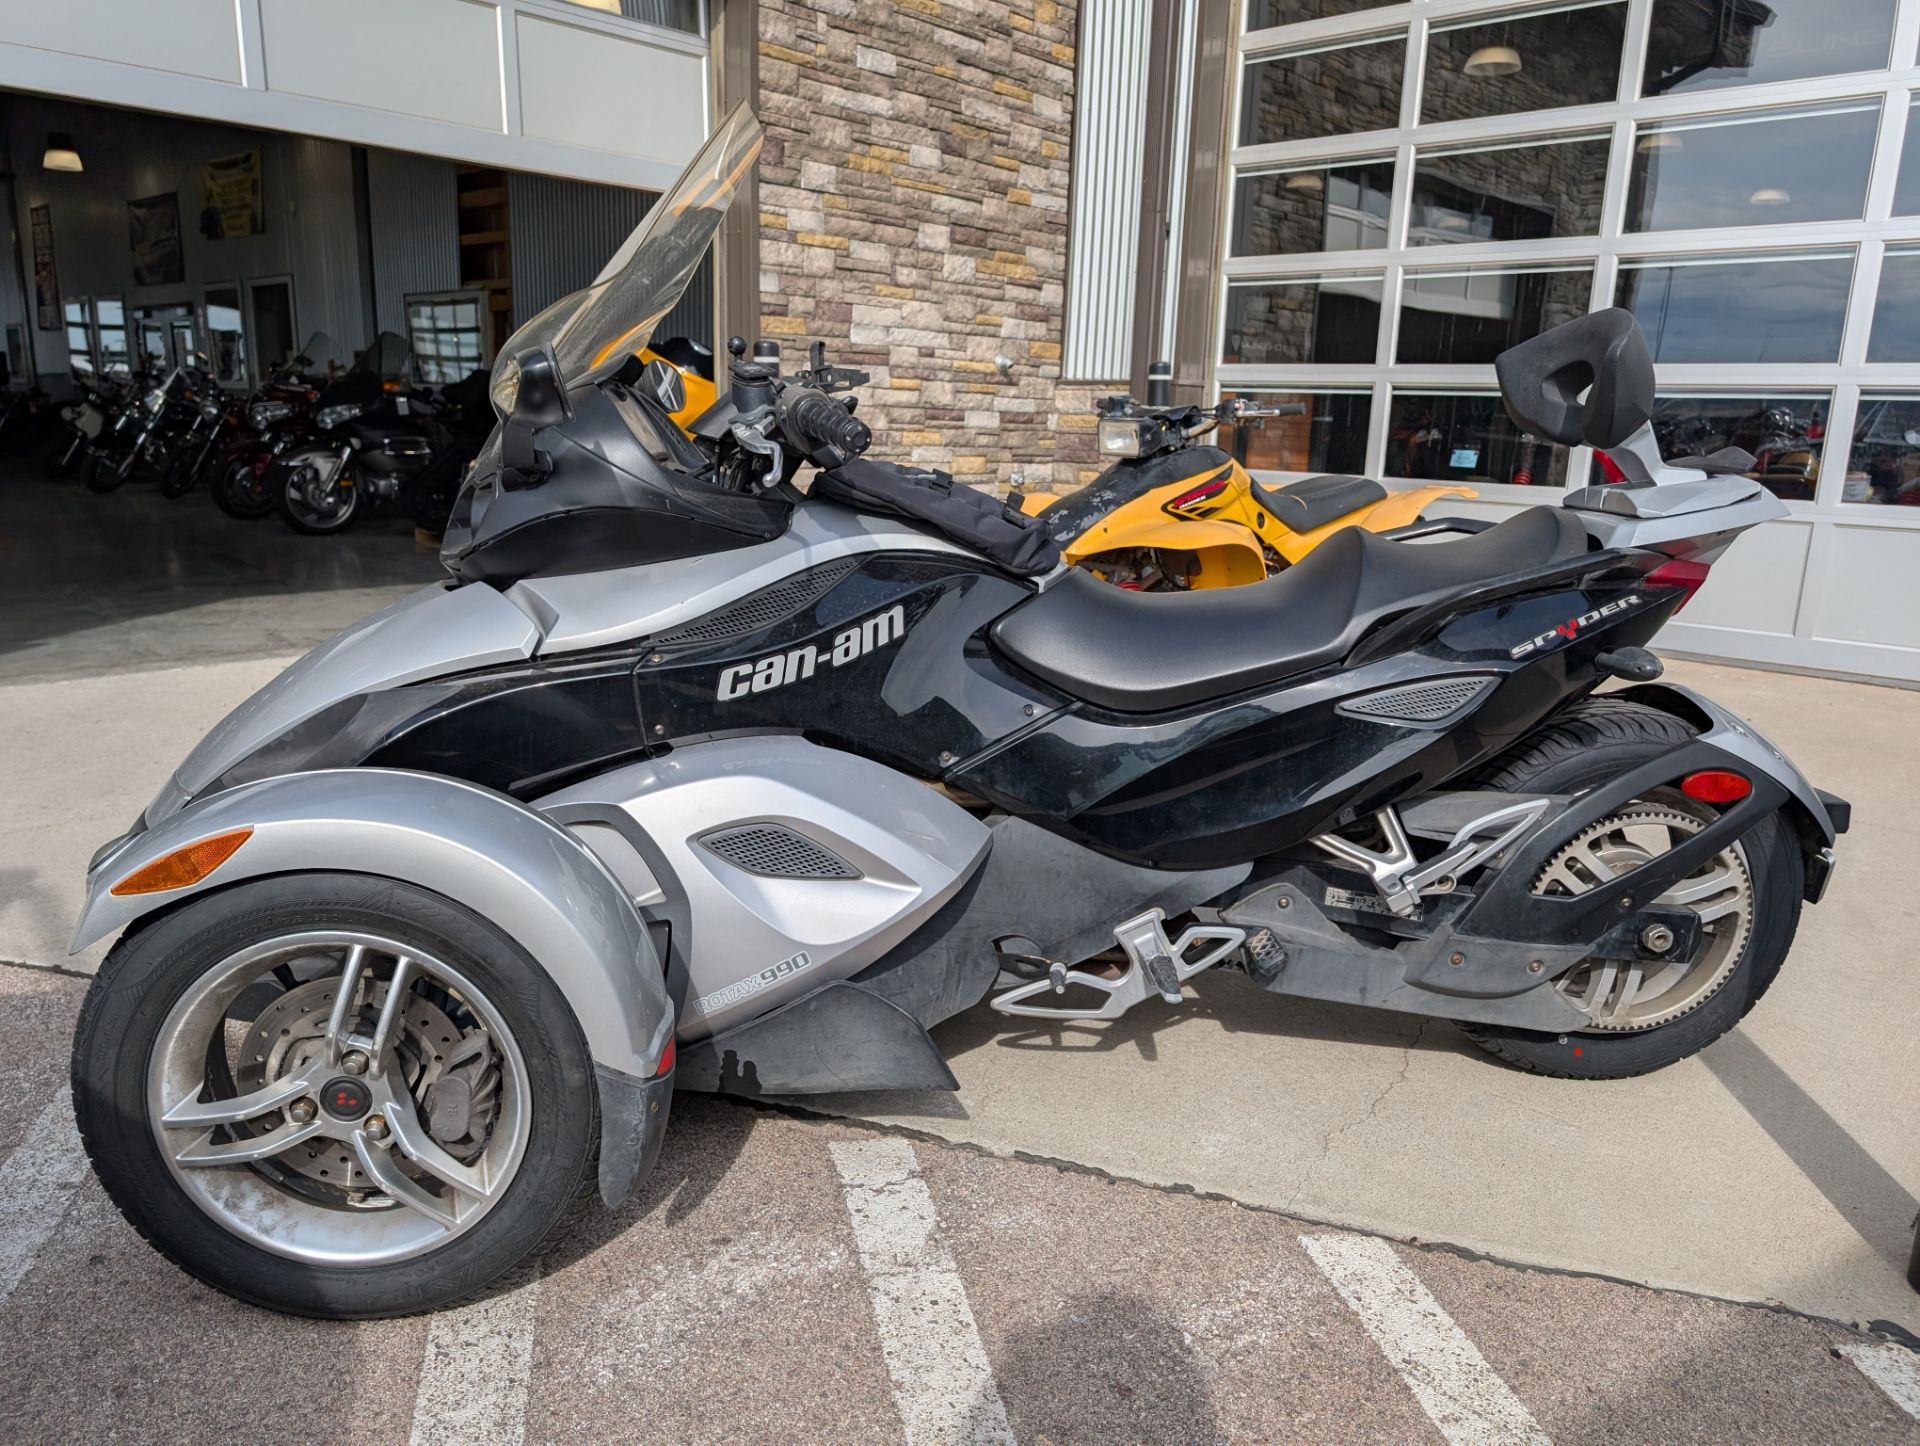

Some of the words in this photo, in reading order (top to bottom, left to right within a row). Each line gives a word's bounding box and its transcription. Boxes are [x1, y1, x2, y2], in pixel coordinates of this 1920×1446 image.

[716, 604, 905, 702] can-am
[1510, 595, 1642, 660] SPYDER
[694, 975, 762, 1015] ROTAX
[760, 951, 812, 986] 990
